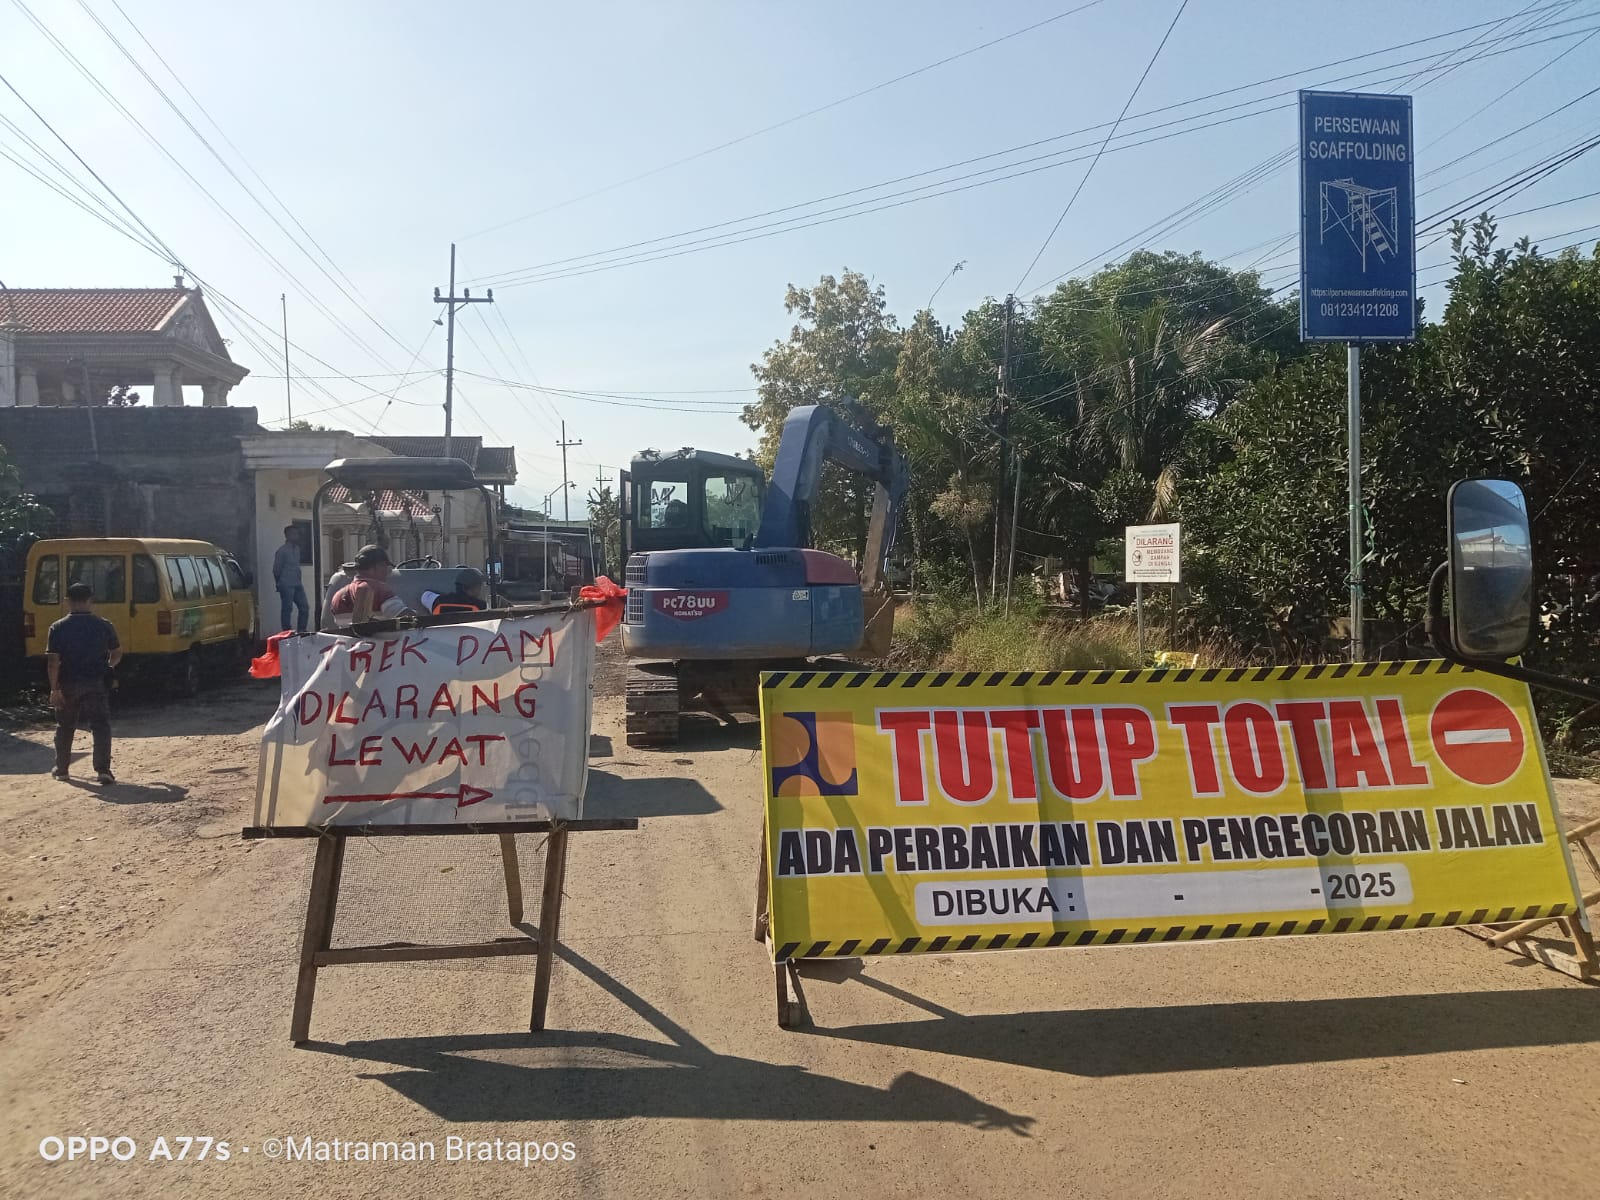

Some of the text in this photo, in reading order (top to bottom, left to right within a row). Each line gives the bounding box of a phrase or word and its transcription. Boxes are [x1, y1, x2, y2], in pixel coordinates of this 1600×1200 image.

[1314, 116, 1400, 135] PERSEWAAN
[1309, 140, 1406, 161] SCAFFOLDING
[1320, 303, 1399, 317] 081234121208
[1136, 537, 1173, 546] DILARANG
[663, 595, 715, 609] PC78UU
[319, 627, 554, 673] TREK DAM
[300, 682, 538, 725] DILARANG
[328, 735, 506, 766] LEWAT
[875, 696, 1433, 806] TUTUP TOTAL
[776, 802, 1544, 877] ADA PERBAIKAN DAN PENGECORAN JALAN
[1327, 872, 1396, 900] 2025
